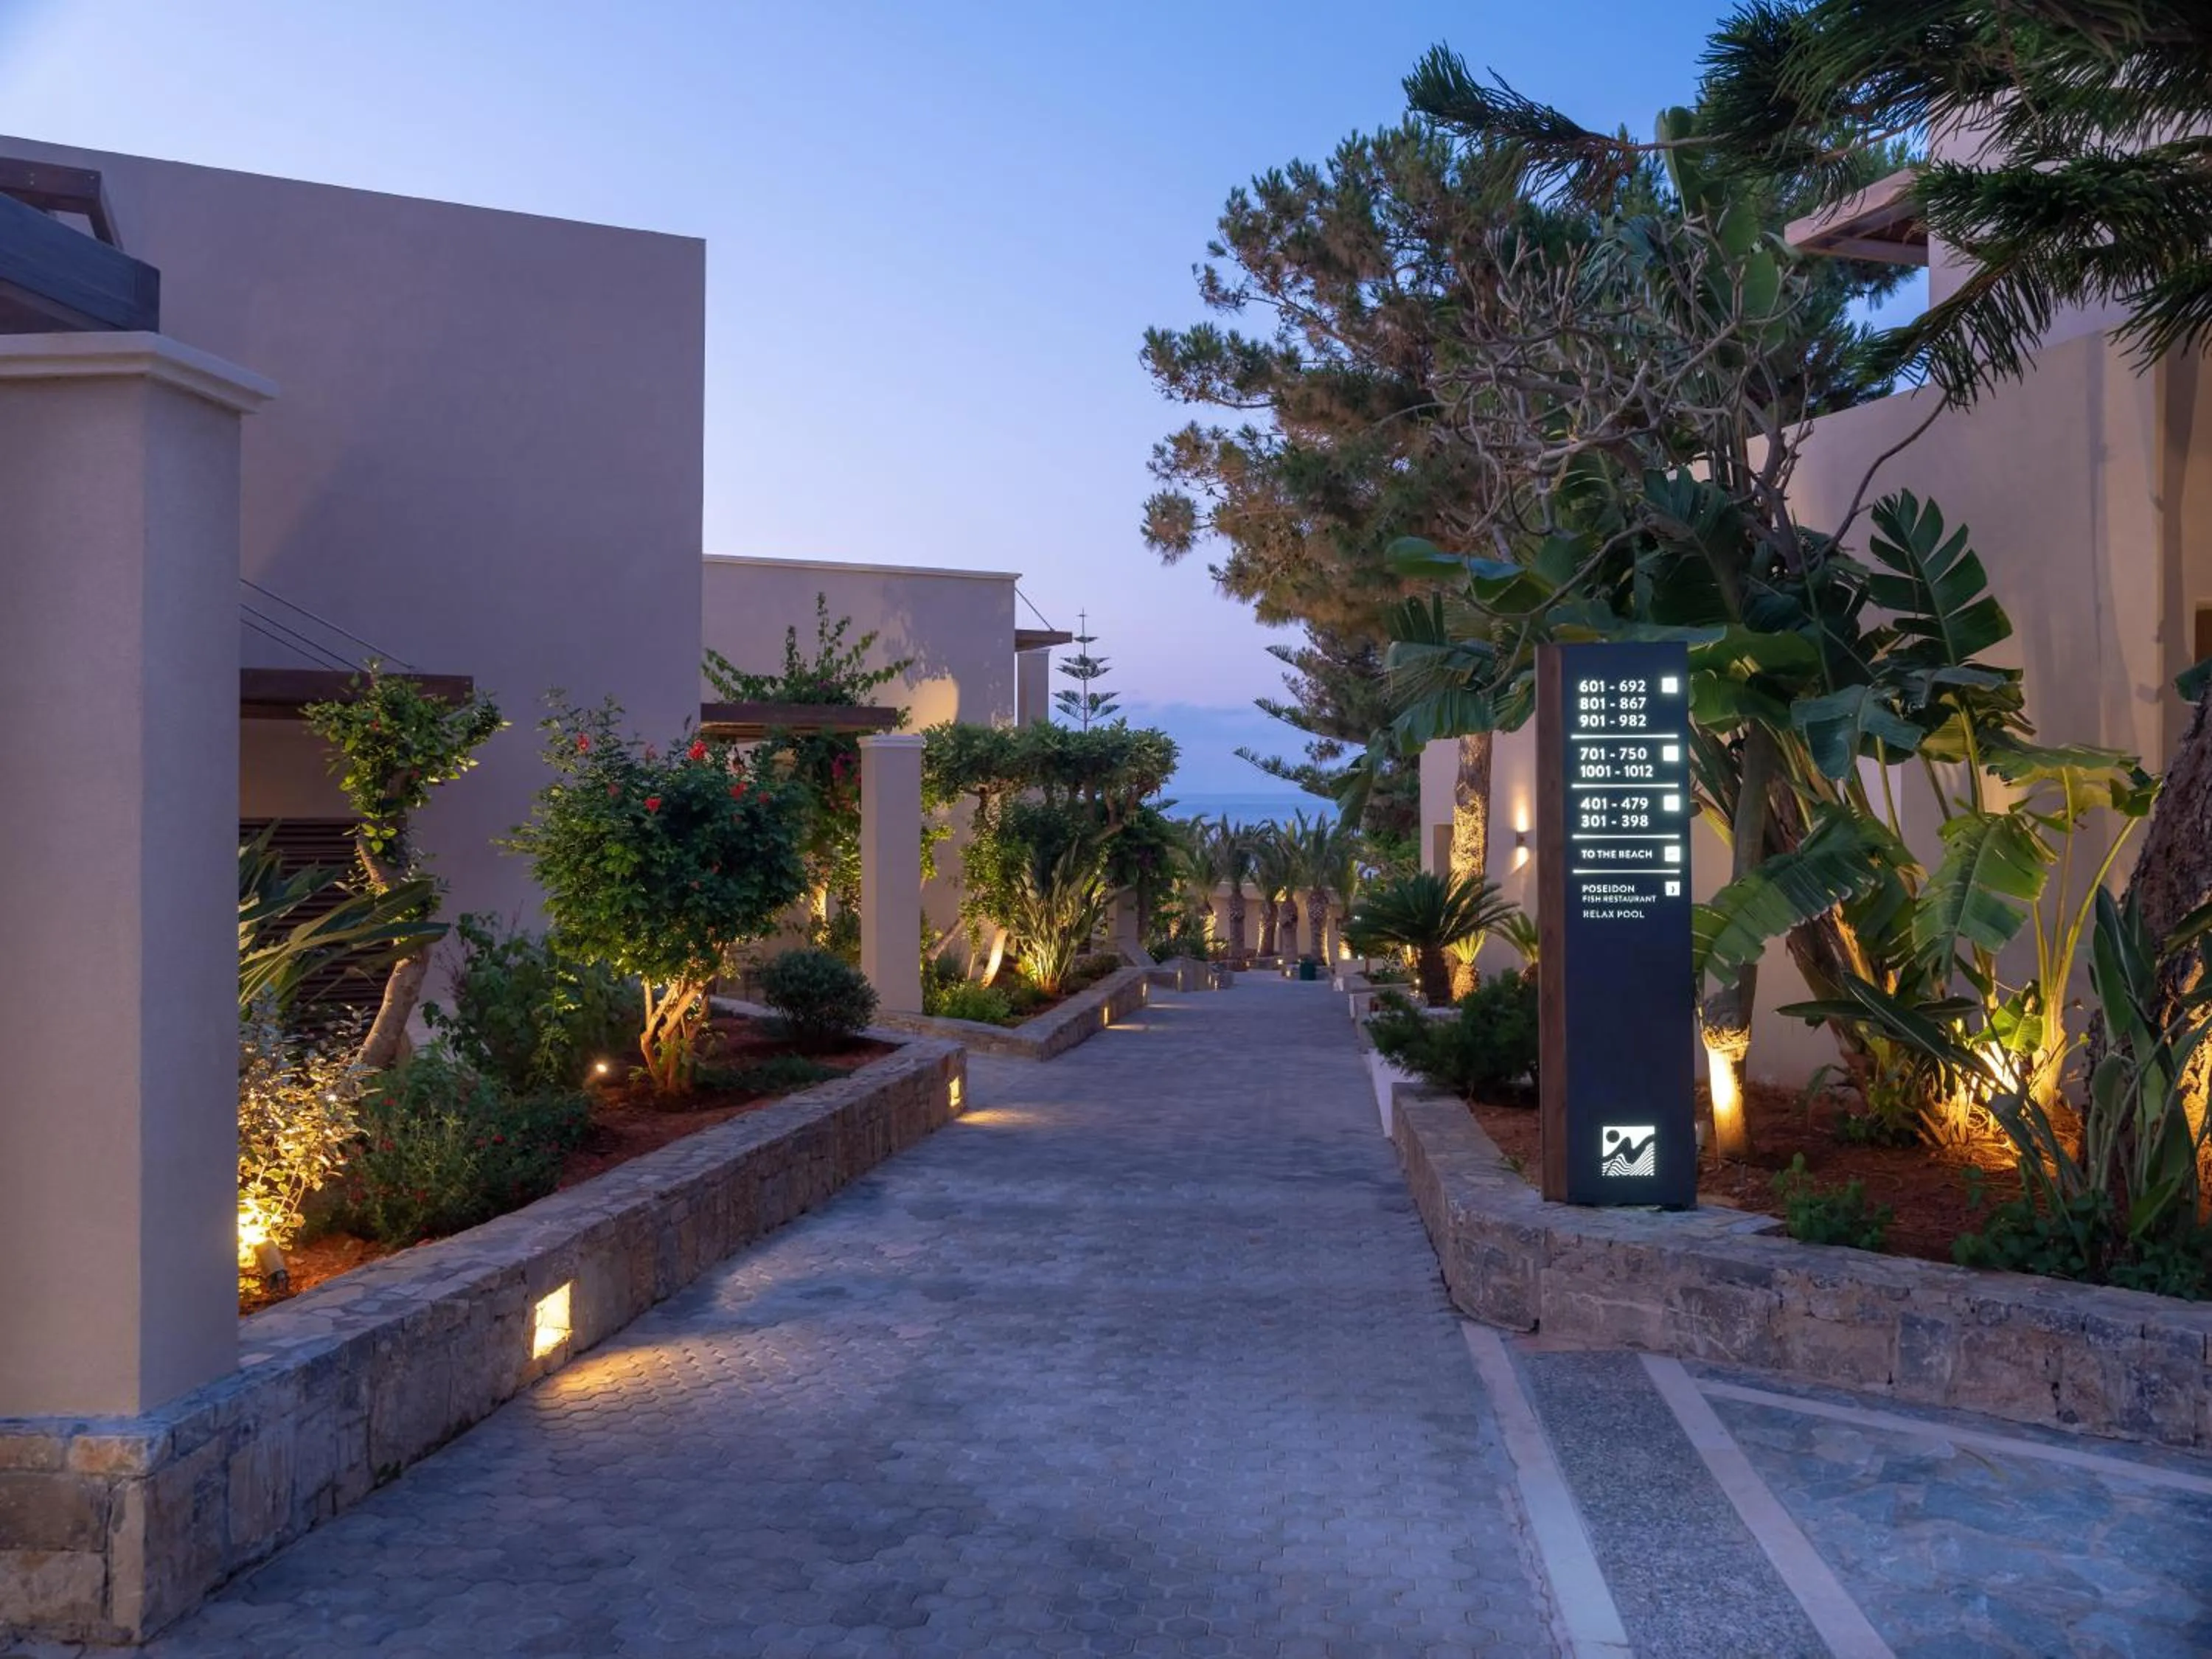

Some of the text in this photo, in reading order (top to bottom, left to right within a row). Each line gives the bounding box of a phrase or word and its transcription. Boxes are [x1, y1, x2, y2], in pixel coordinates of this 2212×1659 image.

[1579, 679, 1605, 693] 601
[1618, 679, 1646, 693] 692
[1579, 696, 1606, 710] 801
[1618, 696, 1647, 710] 867
[1579, 713, 1606, 728] 901
[1618, 713, 1647, 728] 982
[1579, 746, 1606, 761] 701
[1618, 746, 1648, 761] 750
[1579, 764, 1612, 779] 1001
[1623, 764, 1654, 778] 1012
[1579, 796, 1607, 811] 401
[1620, 796, 1649, 810] 479
[1580, 814, 1607, 828] 301
[1621, 814, 1649, 828] 398
[1581, 849, 1653, 859] TO THE BEACH
[1582, 884, 1635, 893] POSEIDON
[1582, 894, 1657, 903] FISH RESTAURANT
[1583, 909, 1645, 919] RELAX POOL
